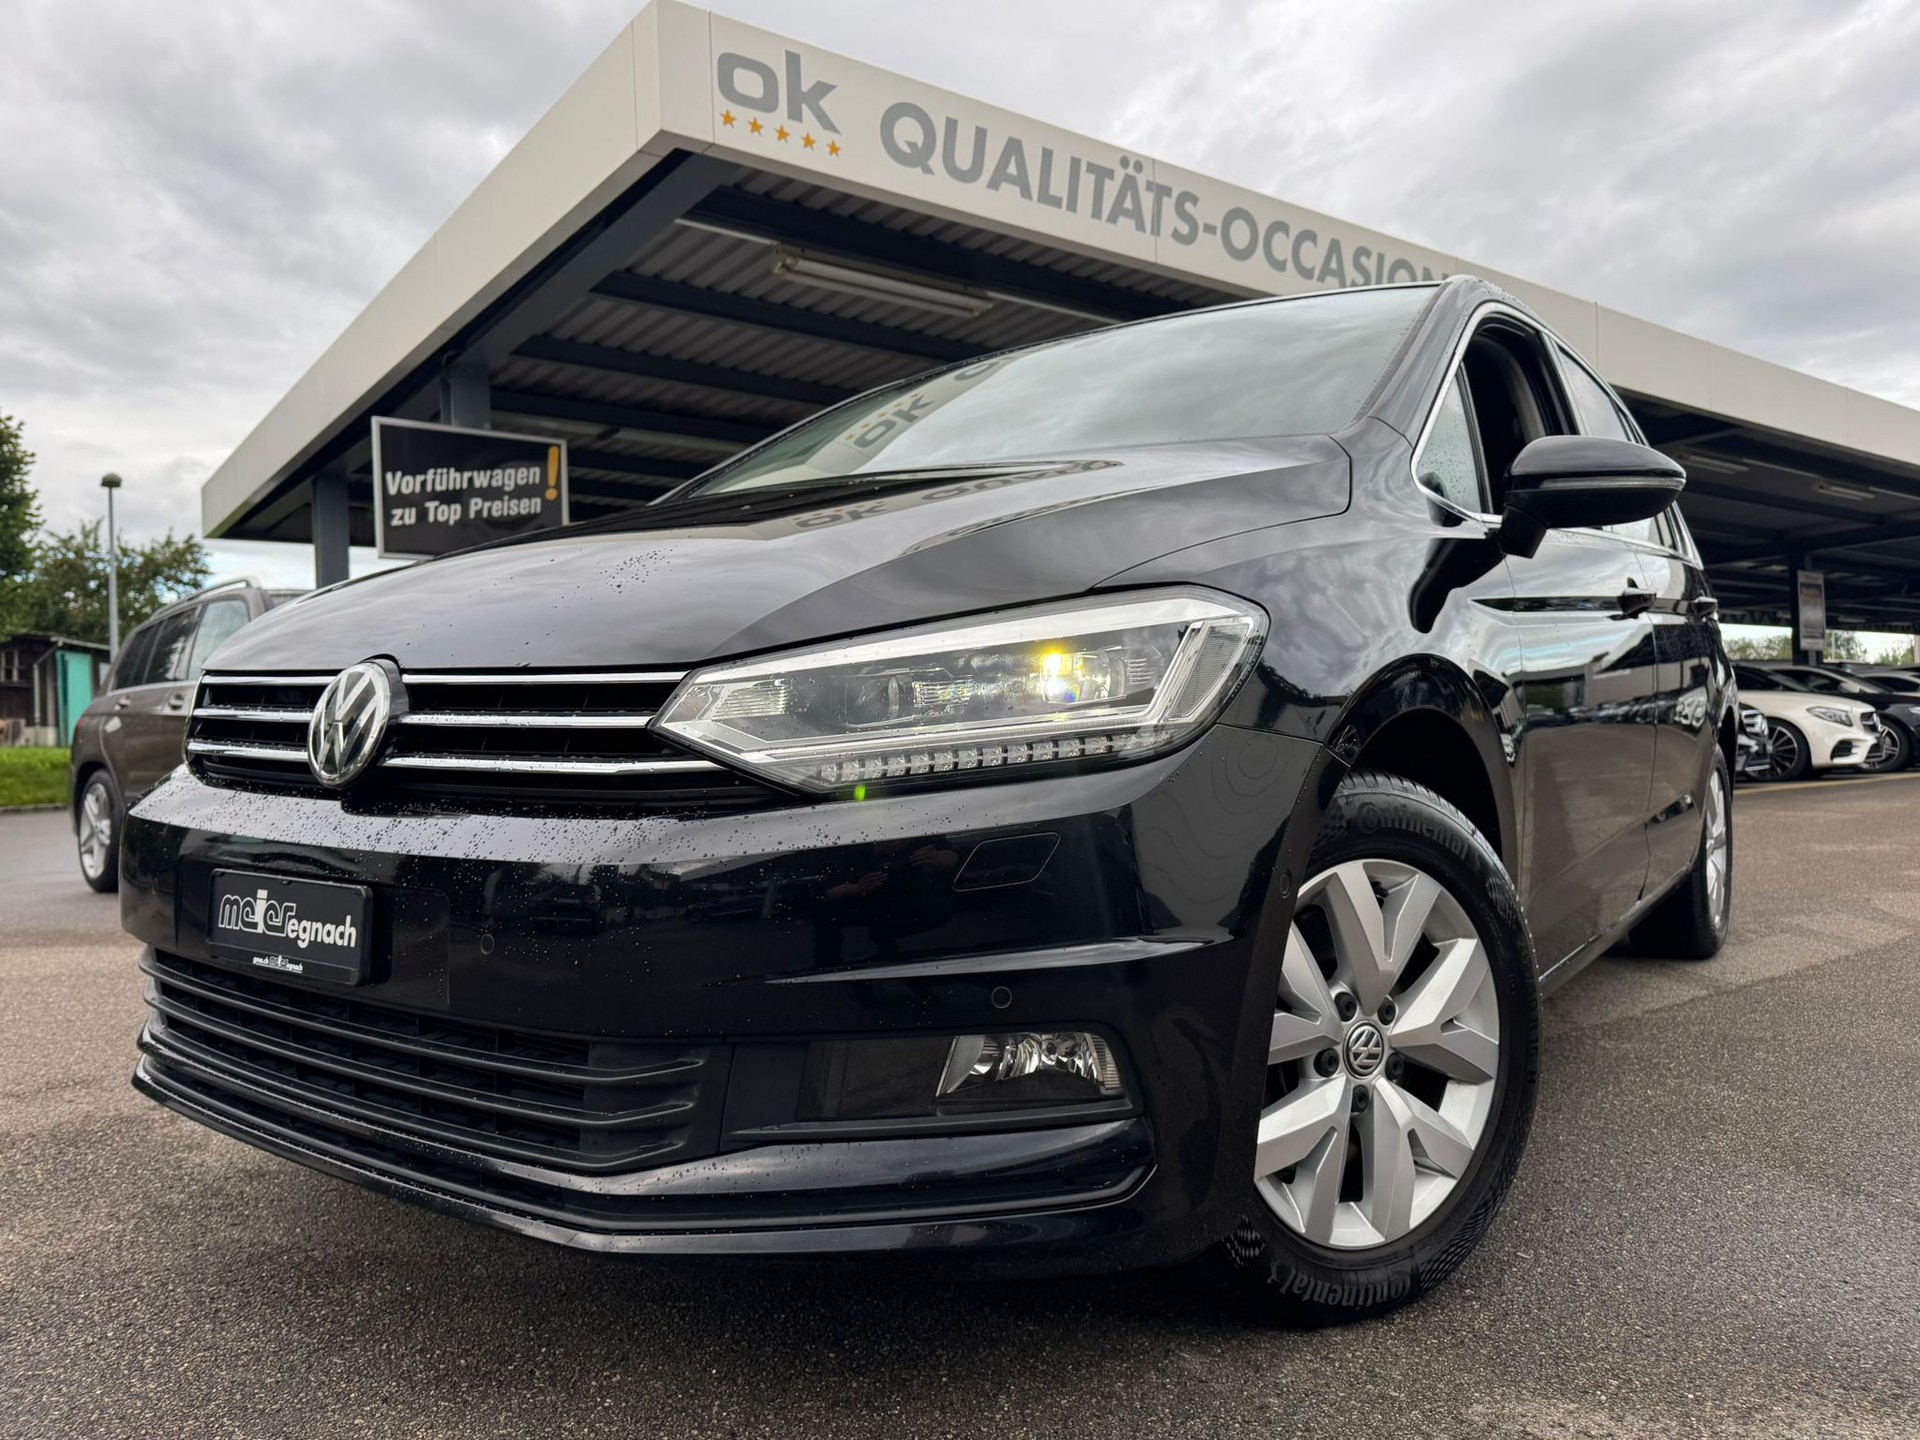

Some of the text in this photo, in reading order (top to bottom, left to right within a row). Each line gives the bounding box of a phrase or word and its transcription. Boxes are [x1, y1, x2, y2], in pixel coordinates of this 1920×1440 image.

[716, 50, 842, 136] ok
[385, 466, 541, 496] Vorführwagen
[390, 495, 542, 526] zu Top Preisen
[287, 914, 357, 949] egnach
